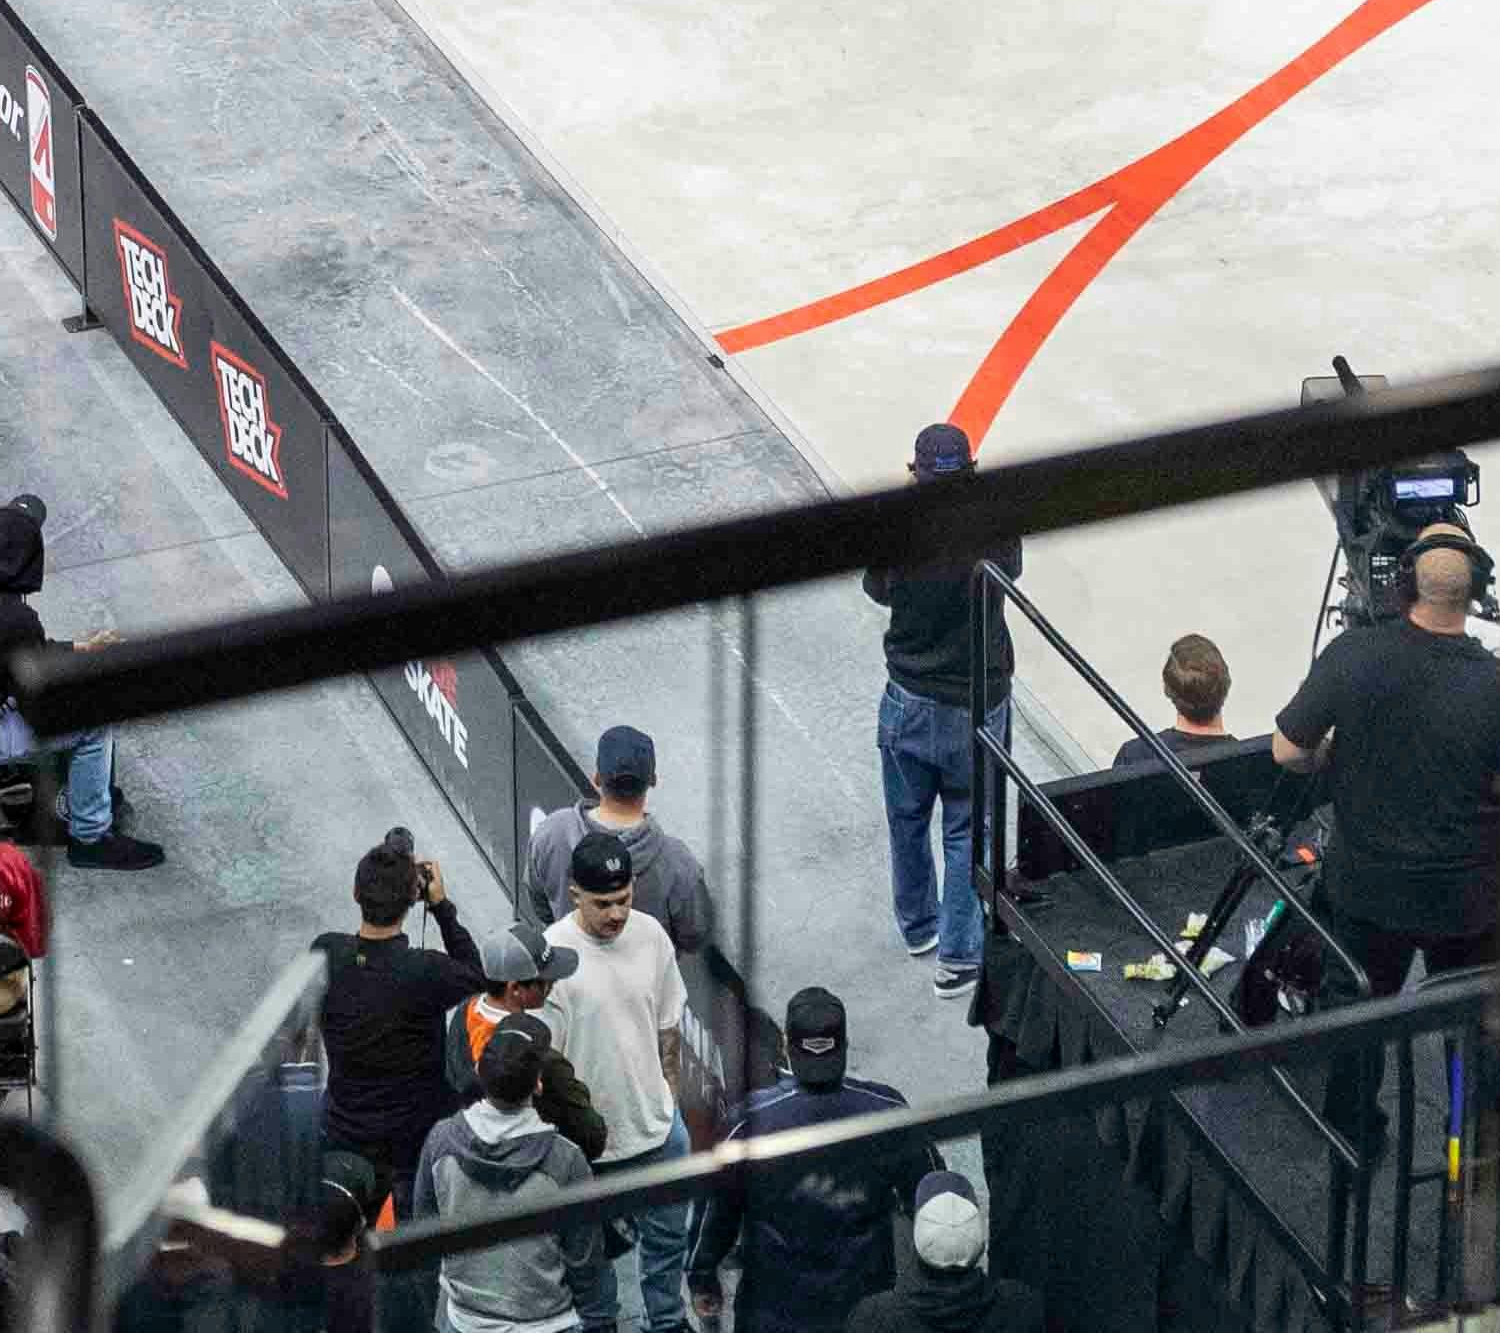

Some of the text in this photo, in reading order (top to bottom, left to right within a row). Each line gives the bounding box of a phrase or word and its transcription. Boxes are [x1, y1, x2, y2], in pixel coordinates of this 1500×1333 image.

[119, 234, 169, 304] TECH
[130, 283, 180, 354] DECK
[216, 356, 267, 428] TECH
[228, 410, 280, 484] DECK
